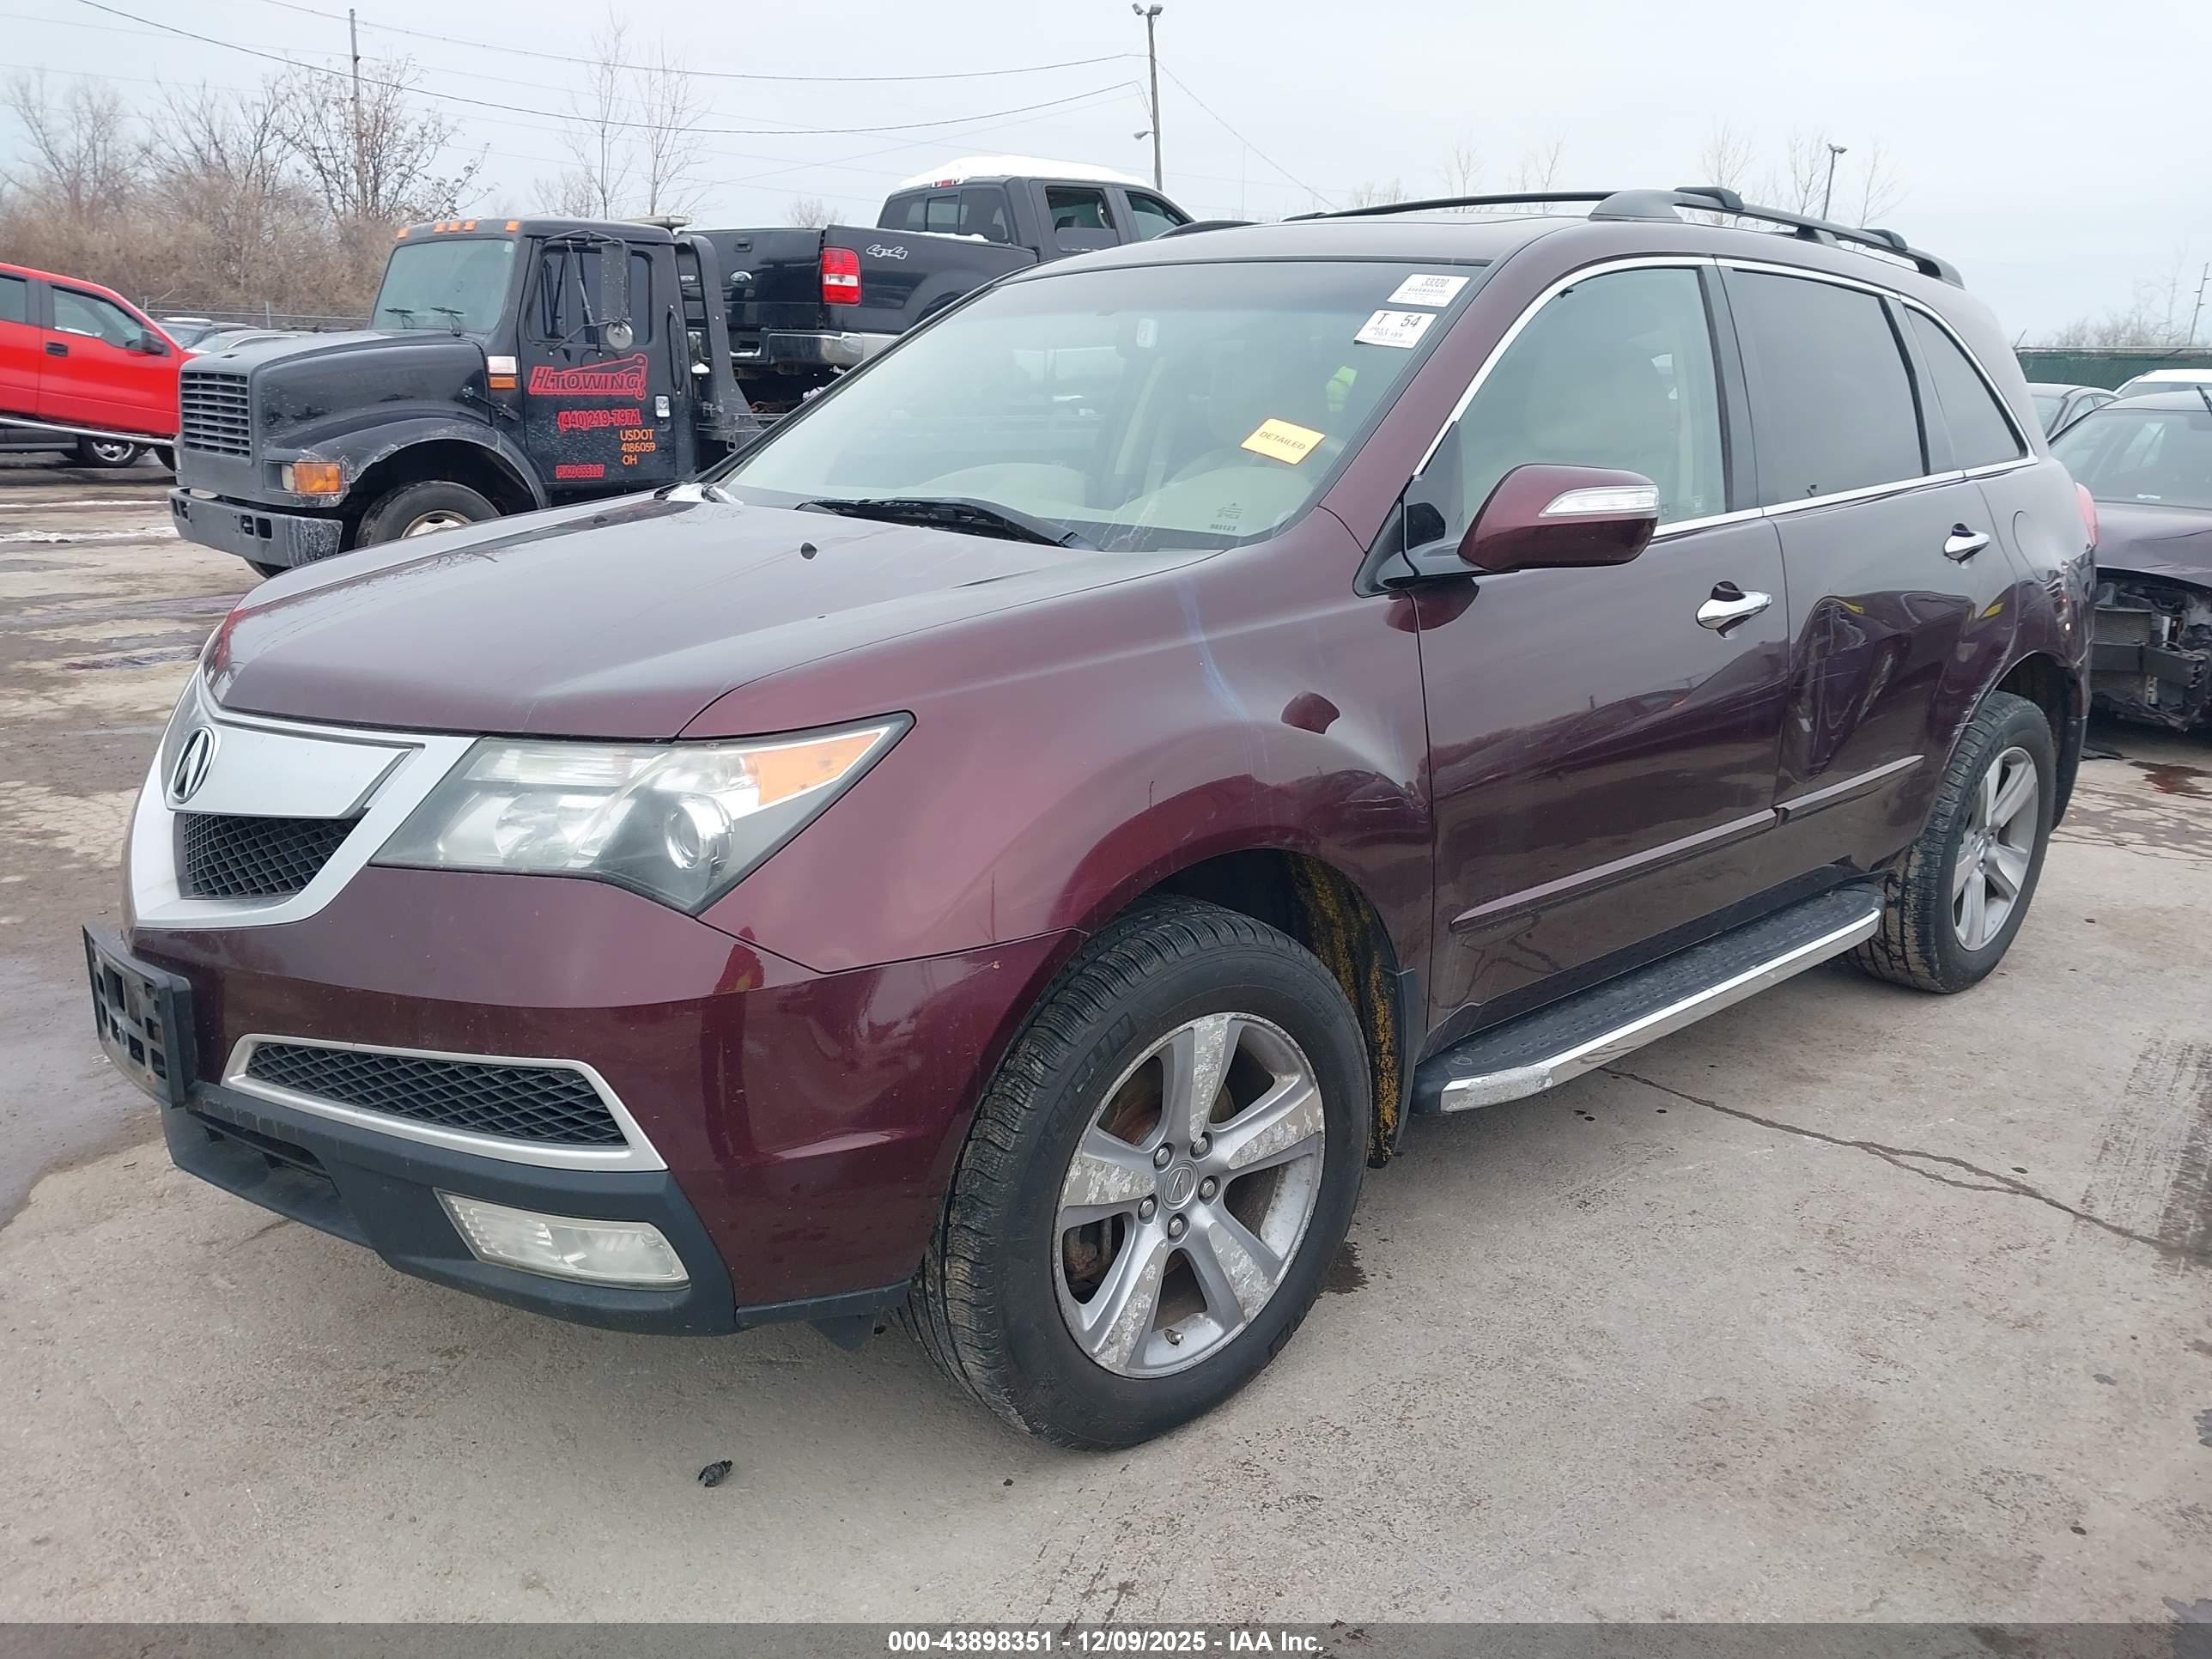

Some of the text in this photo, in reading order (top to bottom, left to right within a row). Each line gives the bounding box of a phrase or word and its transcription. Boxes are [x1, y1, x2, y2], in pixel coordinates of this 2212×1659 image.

[866, 244, 908, 259] 4x4
[1376, 313, 1423, 328] T 54
[558, 409, 641, 431] (440)219-7971
[619, 428, 654, 441] USDOT
[1258, 430, 1307, 451] DETAILED
[621, 441, 656, 453] 4186059
[622, 454, 638, 465] OH
